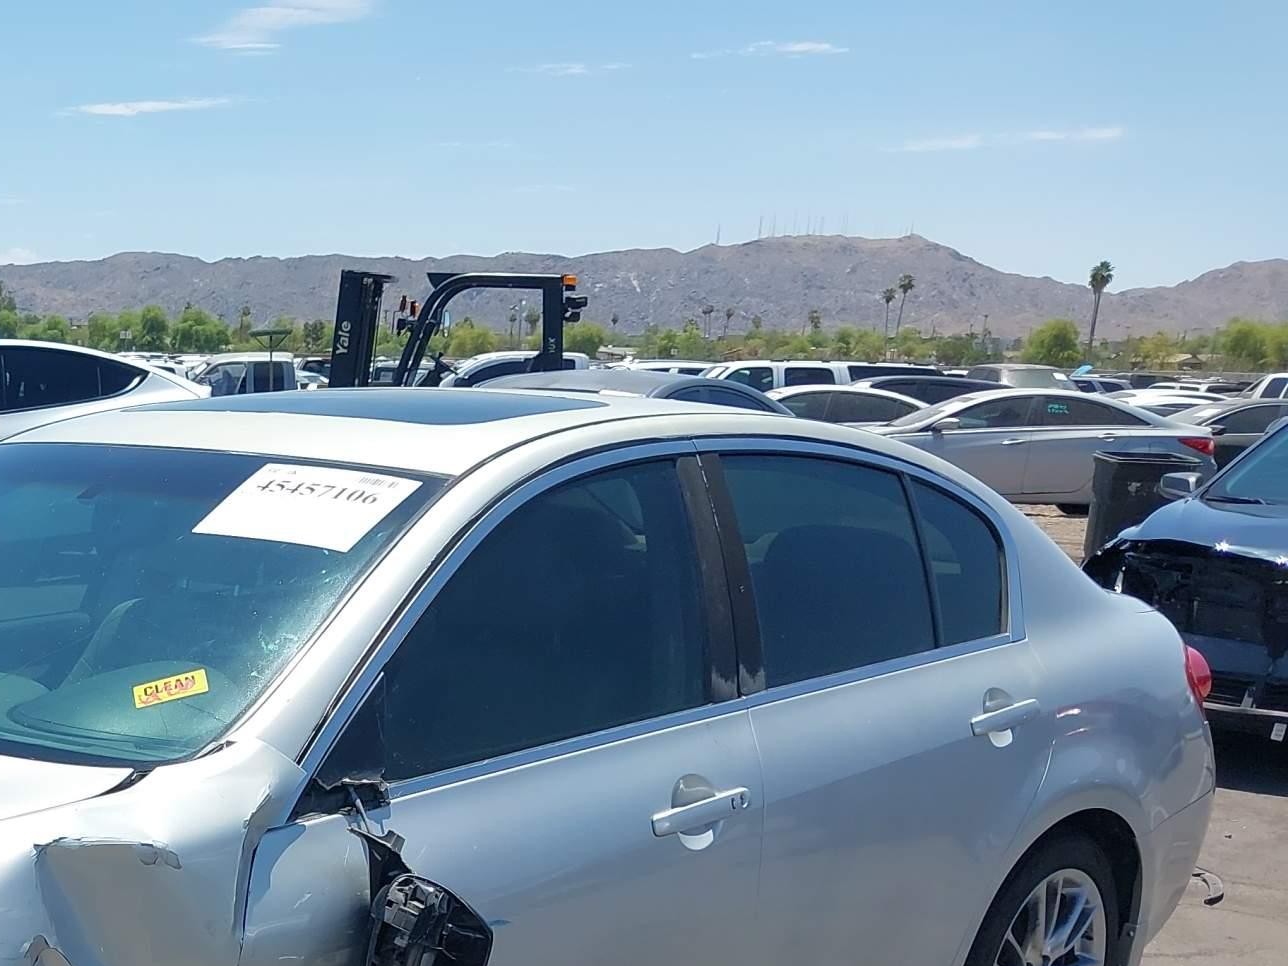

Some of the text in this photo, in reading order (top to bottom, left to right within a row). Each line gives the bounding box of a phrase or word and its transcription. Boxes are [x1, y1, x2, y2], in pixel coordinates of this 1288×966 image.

[335, 320, 351, 355] Yale
[256, 479, 379, 504] 45457106
[143, 675, 196, 697] CLEAN
